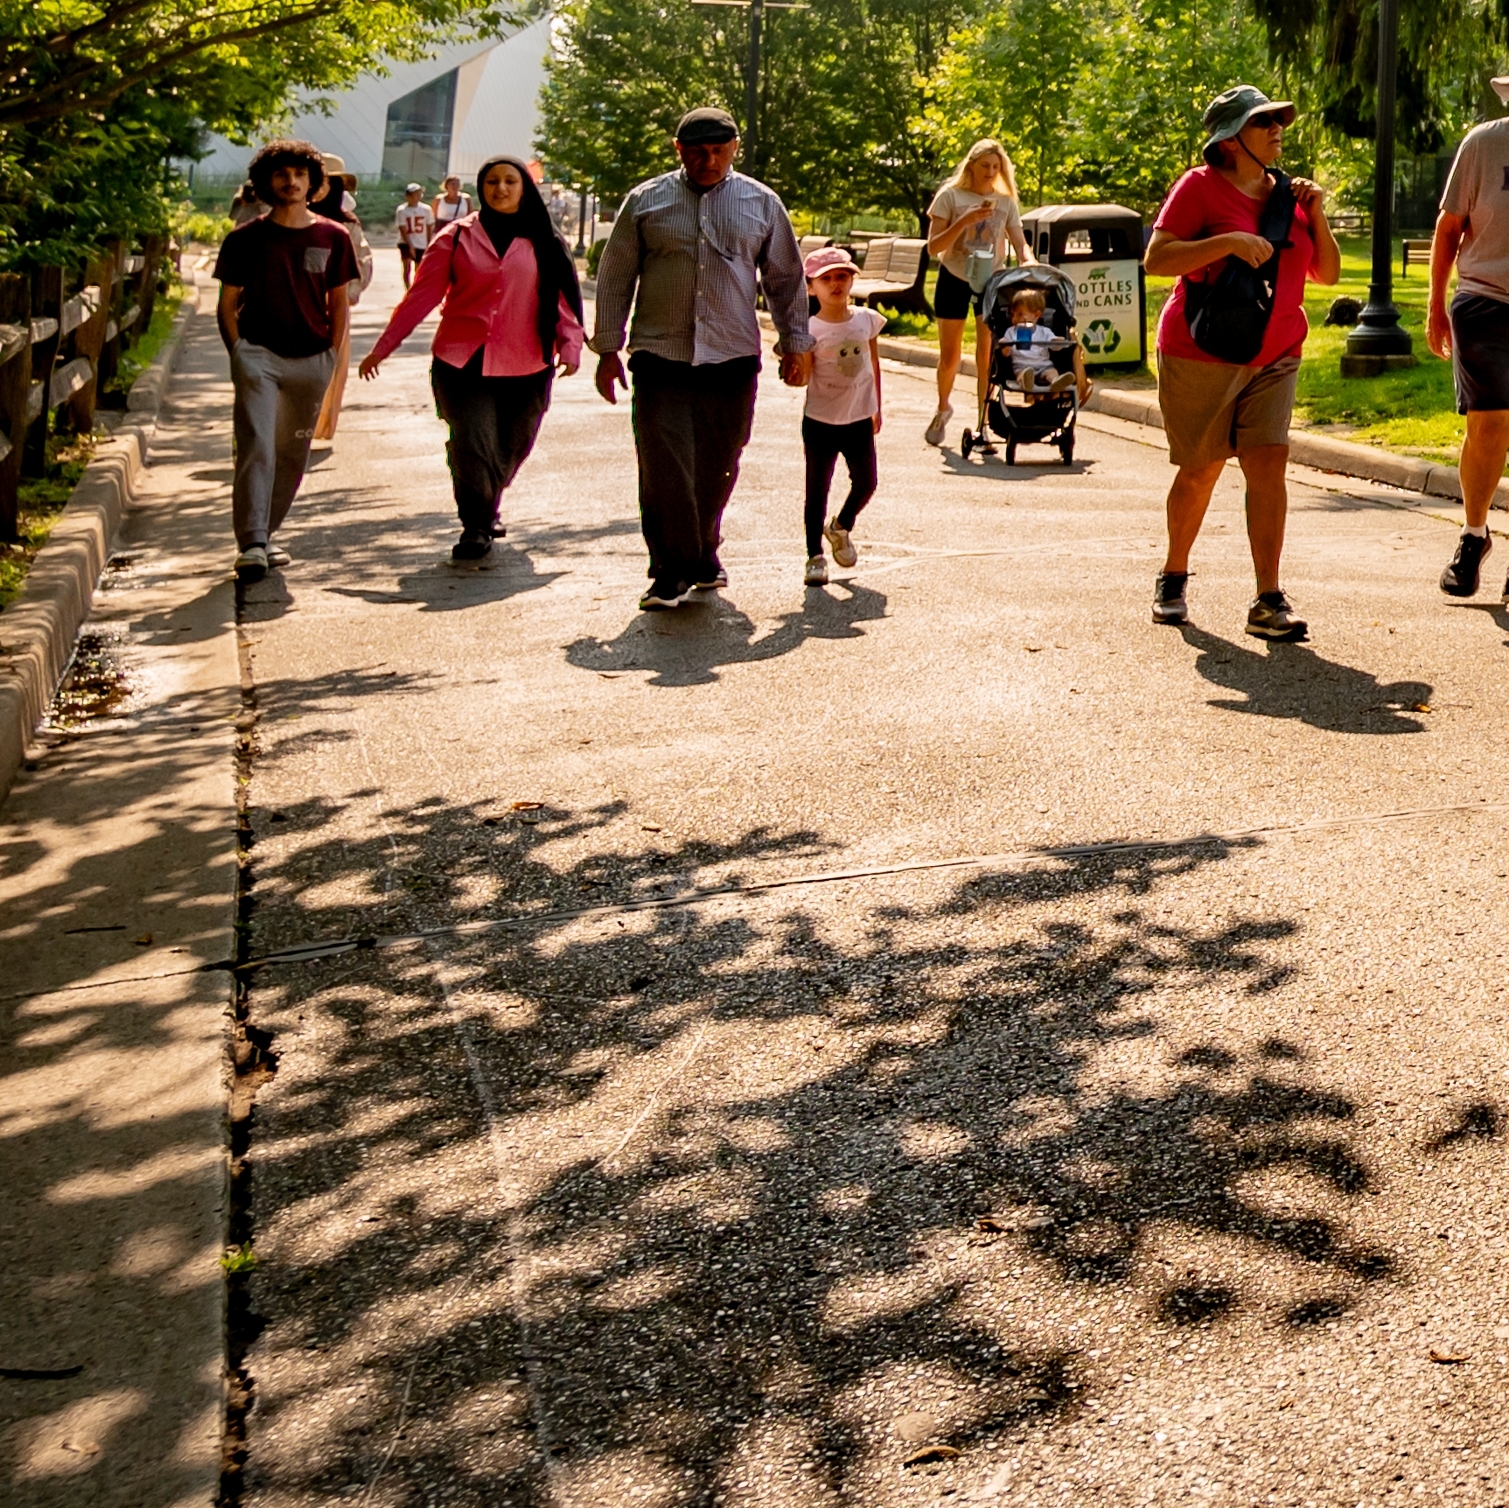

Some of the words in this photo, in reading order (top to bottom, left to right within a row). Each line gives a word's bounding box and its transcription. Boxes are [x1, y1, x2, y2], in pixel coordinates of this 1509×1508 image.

[405, 216, 425, 234] 15
[1078, 280, 1132, 294] OTTLES
[1076, 299, 1090, 307] ND
[1093, 293, 1132, 307] CANS
